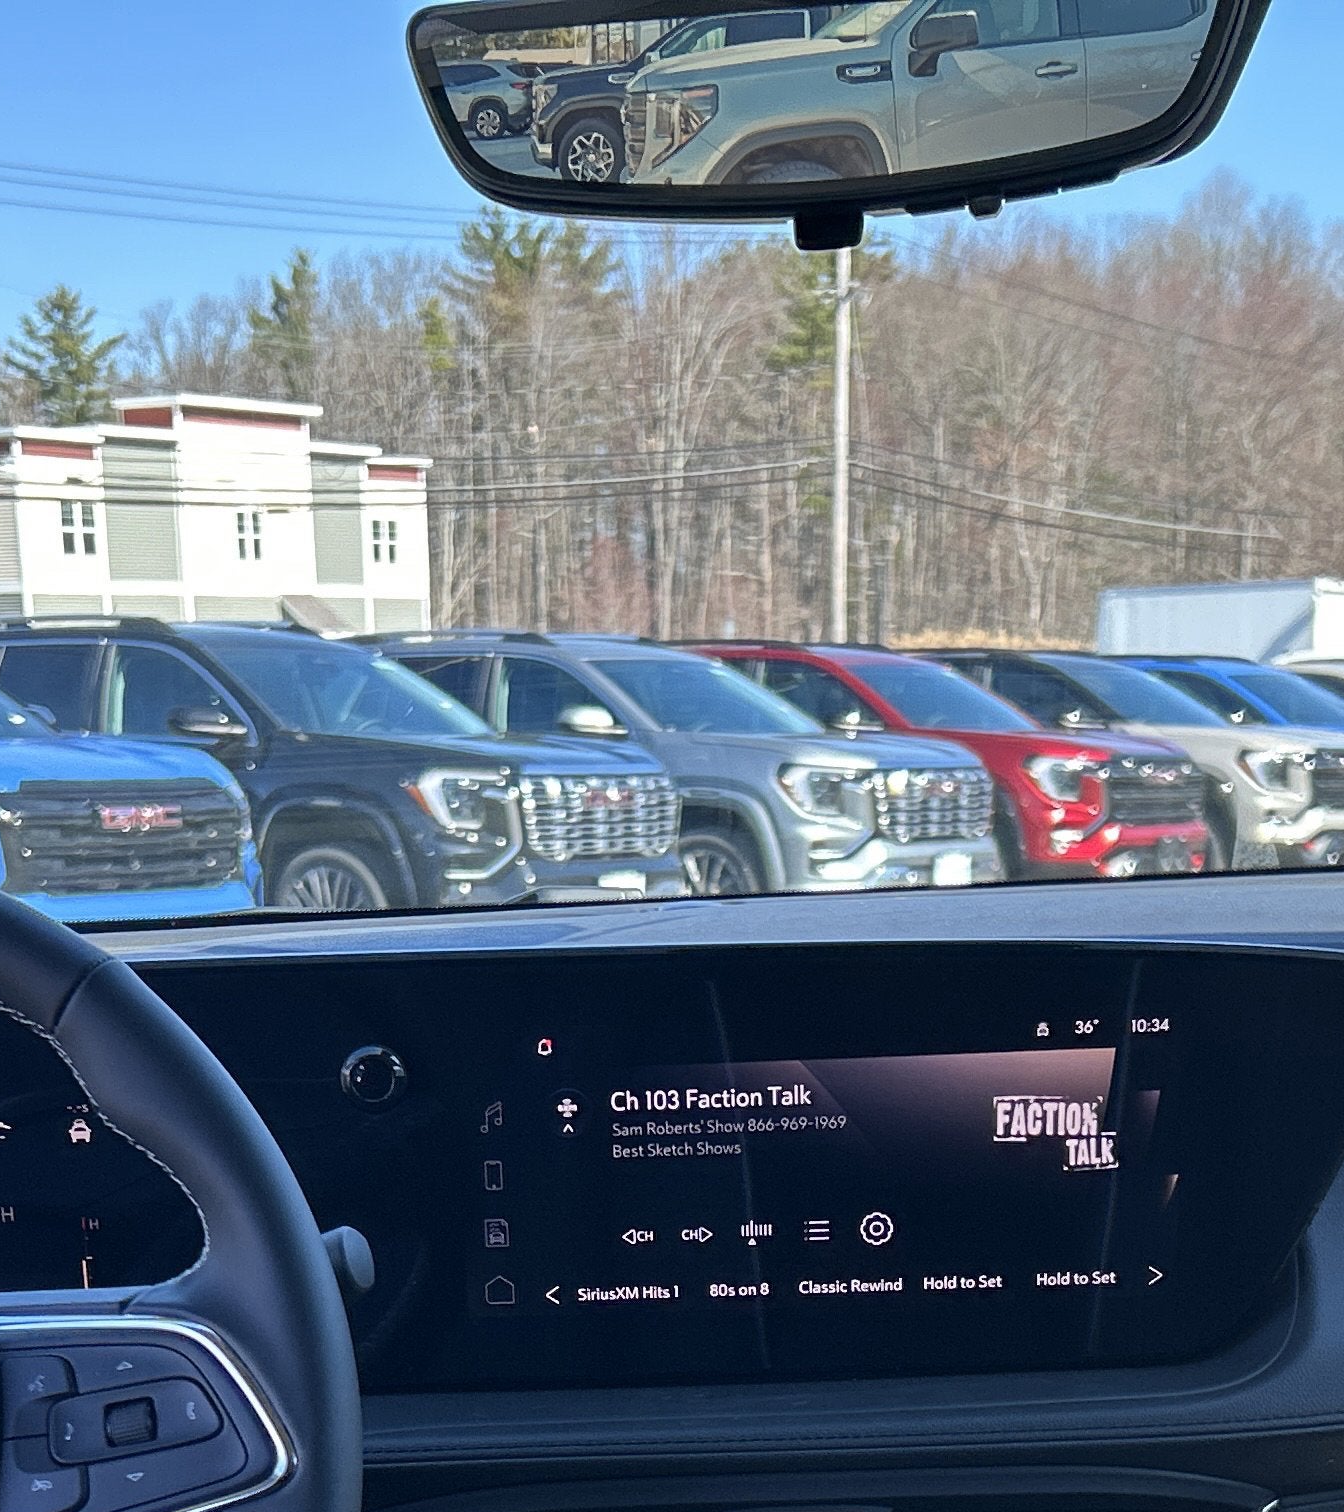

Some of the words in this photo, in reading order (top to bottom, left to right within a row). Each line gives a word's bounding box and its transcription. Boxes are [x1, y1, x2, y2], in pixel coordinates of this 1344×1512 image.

[1074, 1018, 1100, 1035] 36°
[1131, 1017, 1170, 1033] 10:34
[610, 1089, 639, 1112] Ch
[645, 1089, 680, 1111] 103
[685, 1088, 763, 1109] Faction
[766, 1084, 812, 1106] Talk
[612, 1123, 643, 1137] Sam
[646, 1119, 704, 1135] Roberts'
[706, 1119, 745, 1134] Show
[747, 1115, 847, 1132] 866-969-1969
[996, 1102, 1098, 1136] FACTION
[612, 1144, 644, 1159] Best
[647, 1142, 693, 1157] Sketch
[696, 1141, 742, 1156] Shows
[1065, 1137, 1115, 1167] TALK
[636, 1230, 654, 1242] CH
[681, 1229, 699, 1241] CH
[798, 1279, 848, 1295] Classic
[850, 1277, 903, 1293] Rewind
[923, 1275, 957, 1290] Hold
[959, 1277, 976, 1289] to
[978, 1274, 1003, 1289] Set
[1036, 1271, 1071, 1286] Hold
[1073, 1272, 1089, 1285] to
[1091, 1270, 1116, 1285] Set
[577, 1286, 640, 1302] SiriusXM
[642, 1285, 671, 1299] Hits
[673, 1284, 679, 1298] 1
[709, 1283, 736, 1298] 80s
[738, 1286, 757, 1297] on
[759, 1282, 770, 1296] 8
